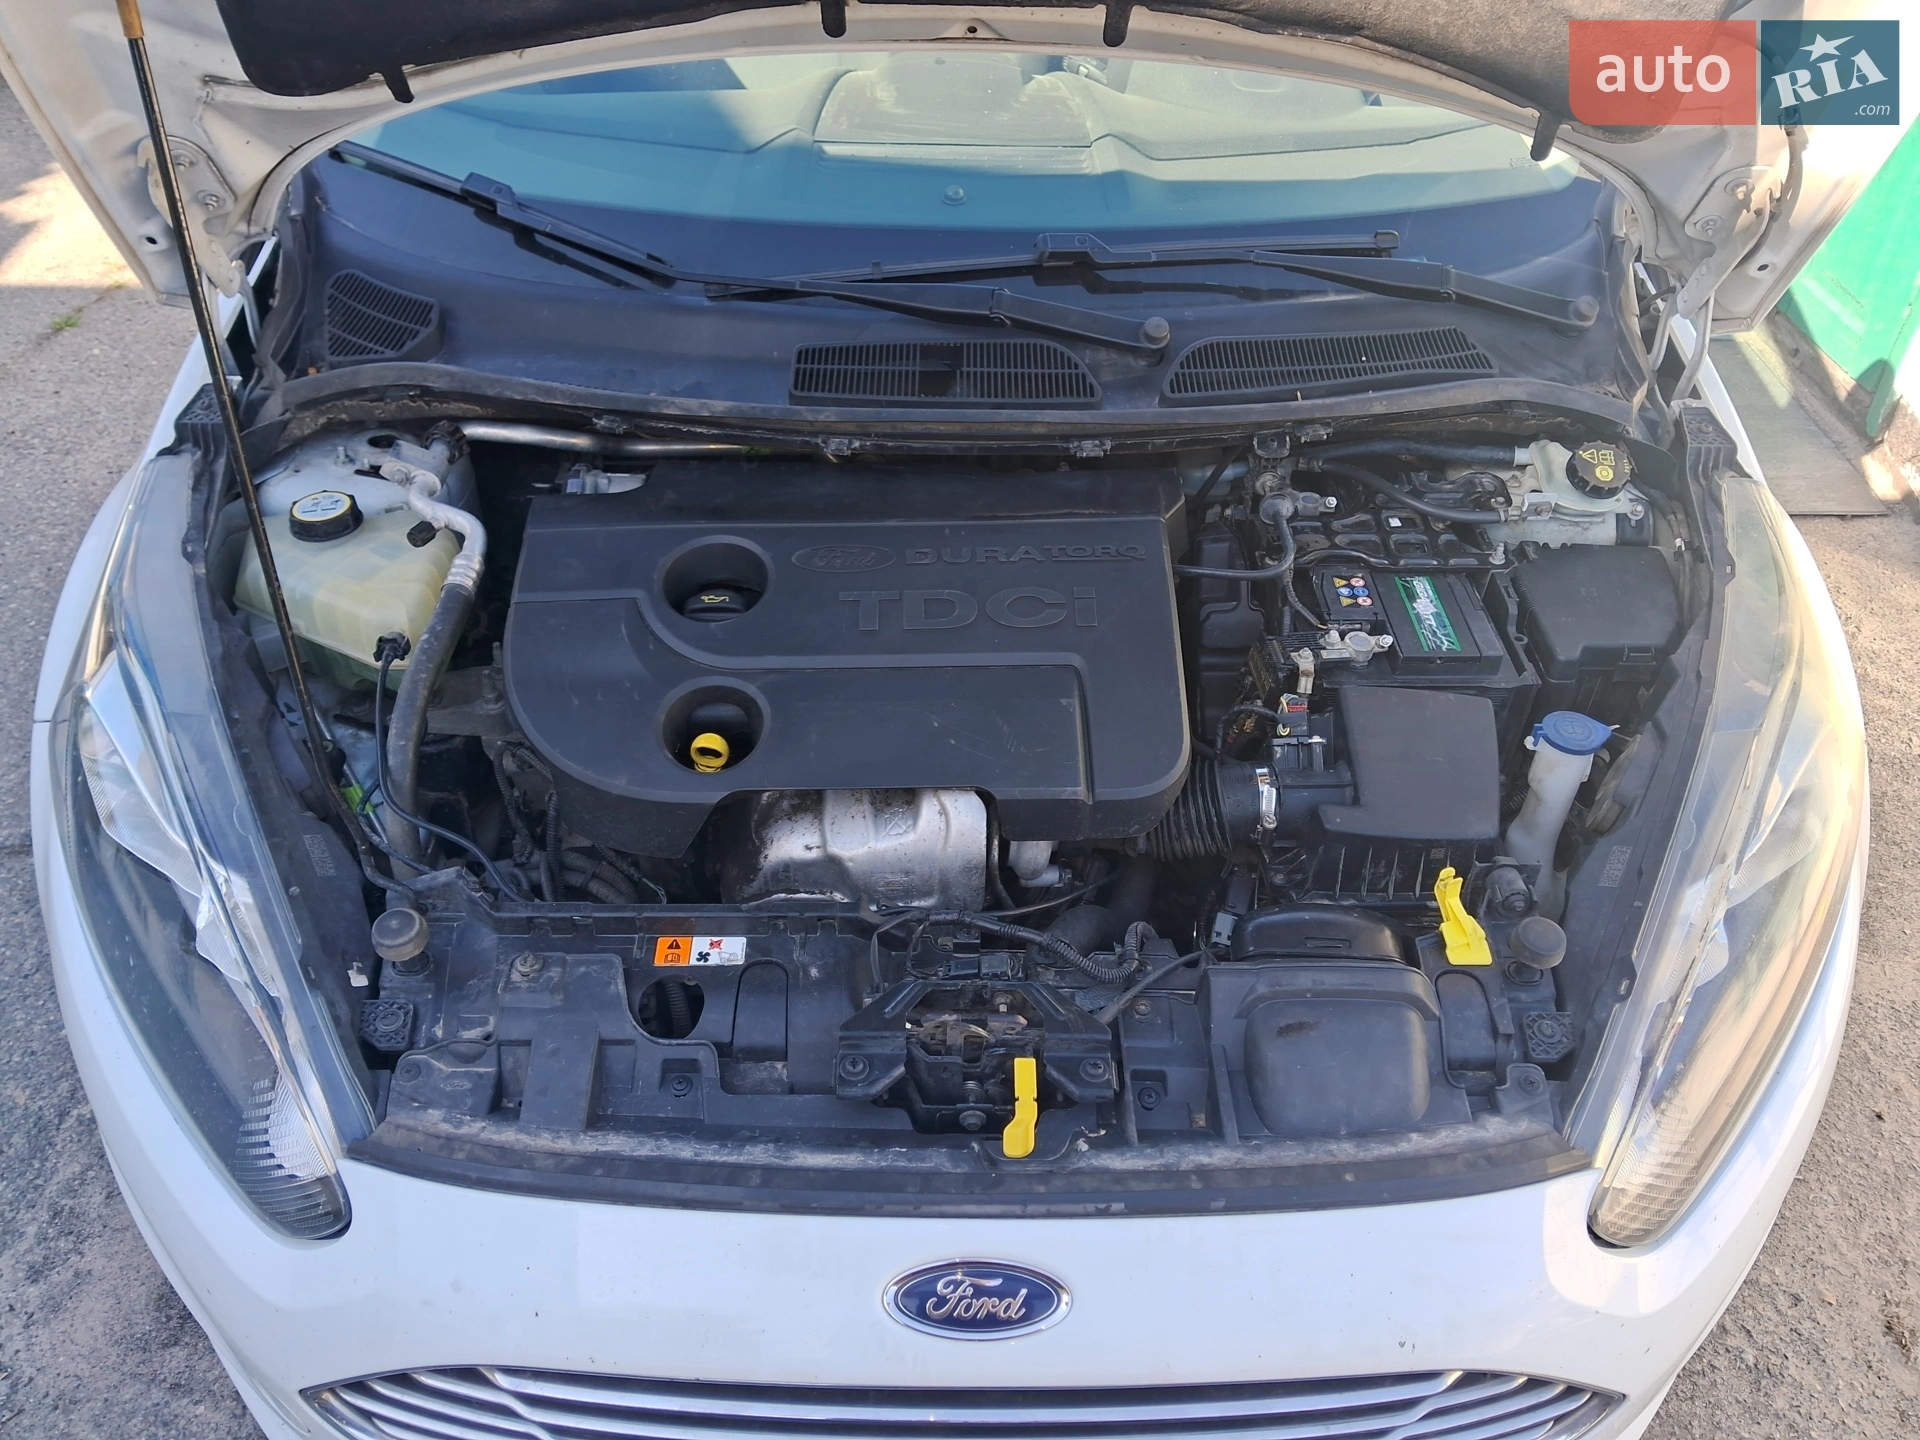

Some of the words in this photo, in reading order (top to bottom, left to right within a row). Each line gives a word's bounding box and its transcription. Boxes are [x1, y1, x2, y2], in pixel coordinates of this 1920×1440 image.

[811, 545, 876, 569] Ford
[905, 544, 1147, 564] DURATORQ
[839, 586, 1098, 632] TDCi
[925, 1275, 1028, 1321] Ford
